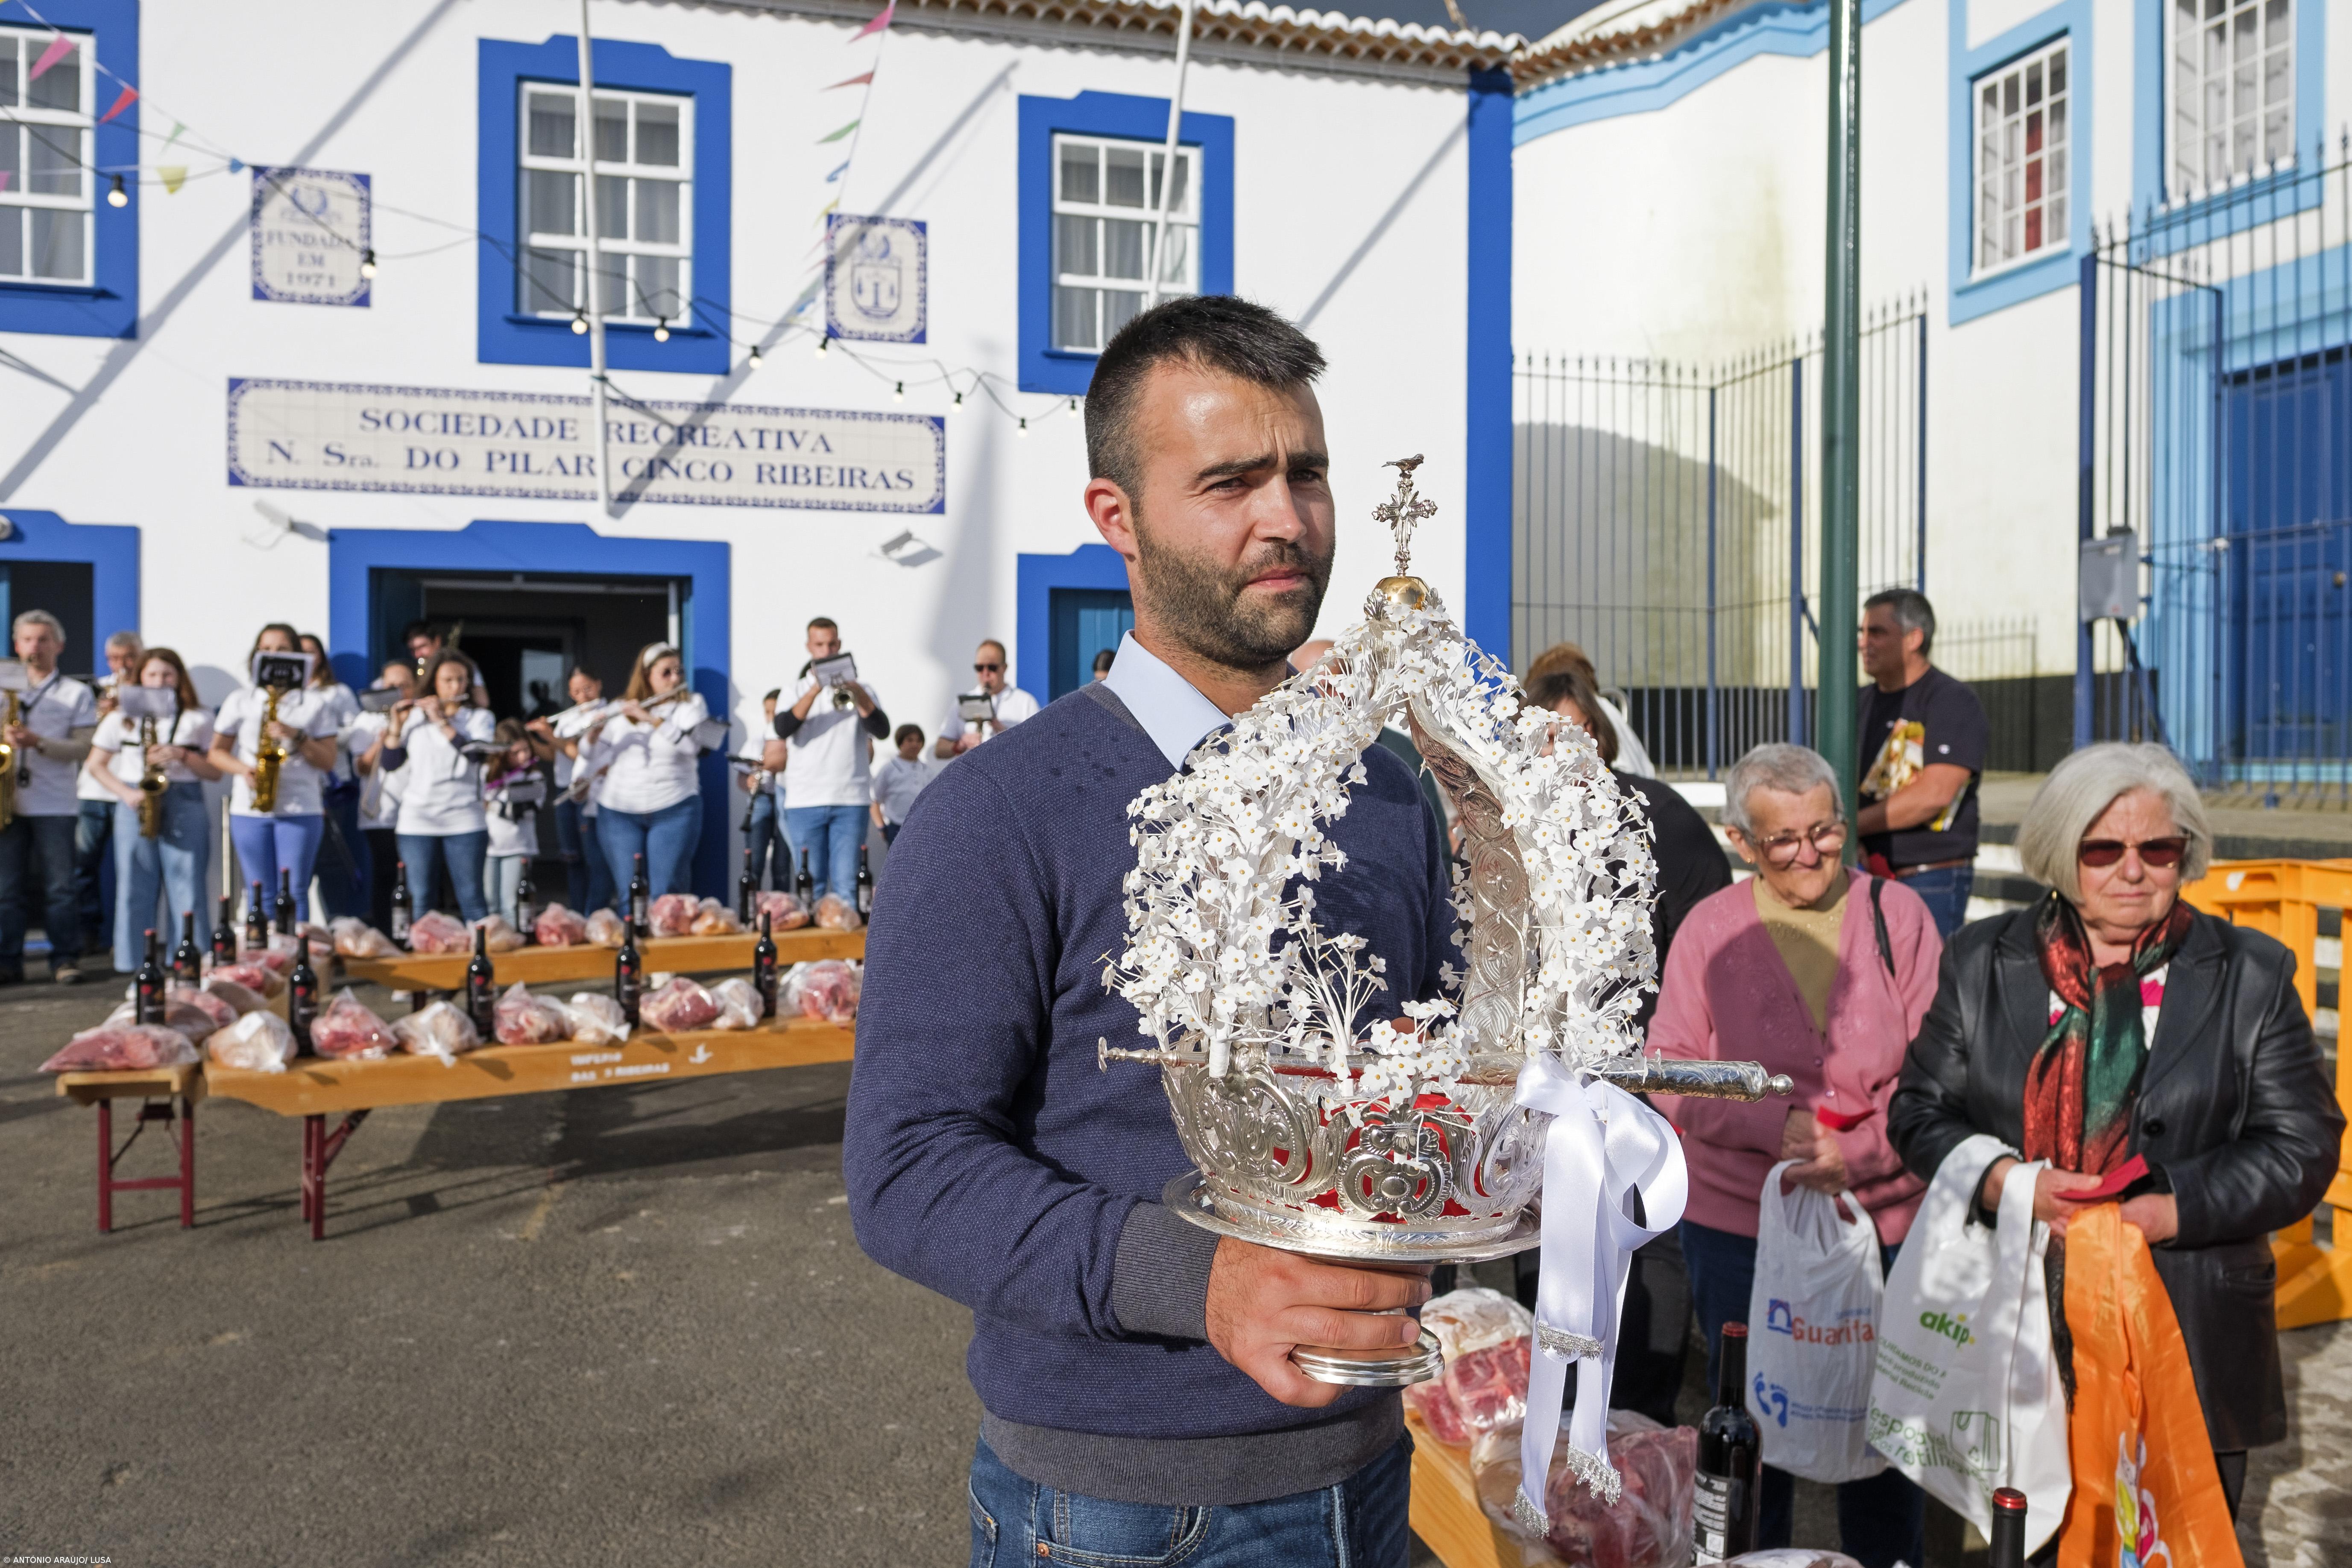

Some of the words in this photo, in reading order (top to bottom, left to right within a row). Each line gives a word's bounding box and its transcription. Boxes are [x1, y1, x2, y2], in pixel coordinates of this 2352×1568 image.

[298, 253, 325, 267] EM
[287, 272, 336, 287] 1971
[360, 407, 579, 442] SOCIEDADE
[605, 421, 834, 454] RECREATIVA
[266, 439, 301, 465] N.
[323, 441, 380, 467] Sra.
[404, 445, 460, 472] DO
[486, 450, 595, 478] PILAR
[622, 456, 733, 483] CINCO
[756, 463, 914, 490] RIBEIRAS
[1792, 1317, 1874, 1345] Guarita
